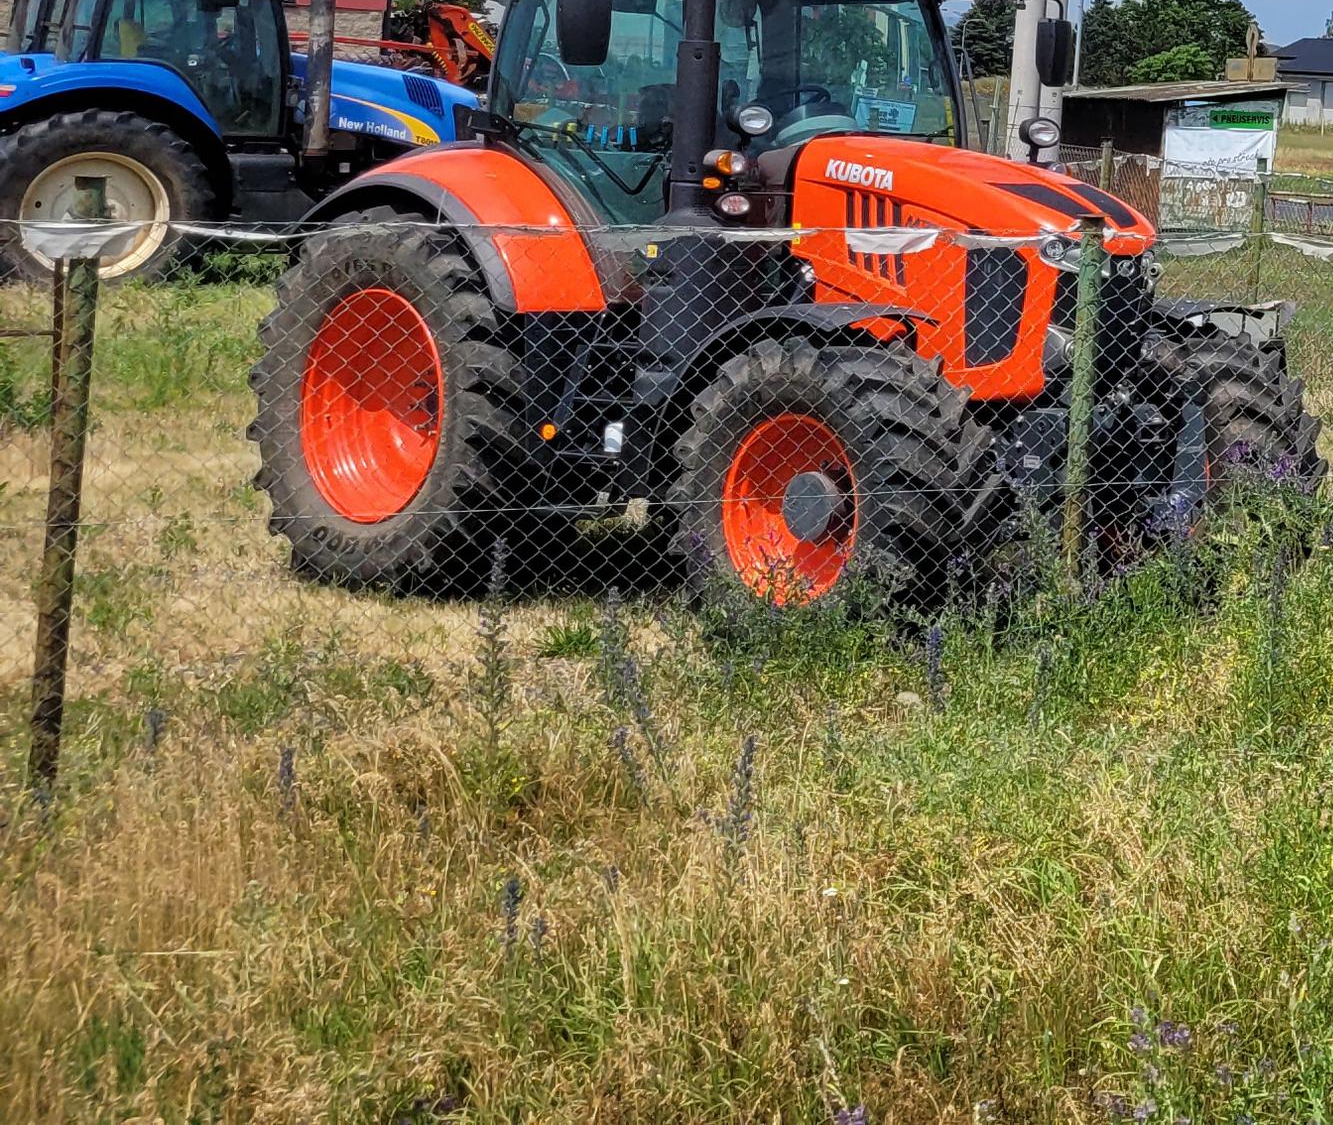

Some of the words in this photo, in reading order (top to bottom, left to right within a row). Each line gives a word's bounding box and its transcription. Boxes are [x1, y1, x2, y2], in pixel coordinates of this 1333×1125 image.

[338, 117, 364, 130] New
[366, 121, 407, 140] Holland
[1221, 115, 1270, 124] PNEUSERVIS
[824, 158, 894, 192] KUBOTA
